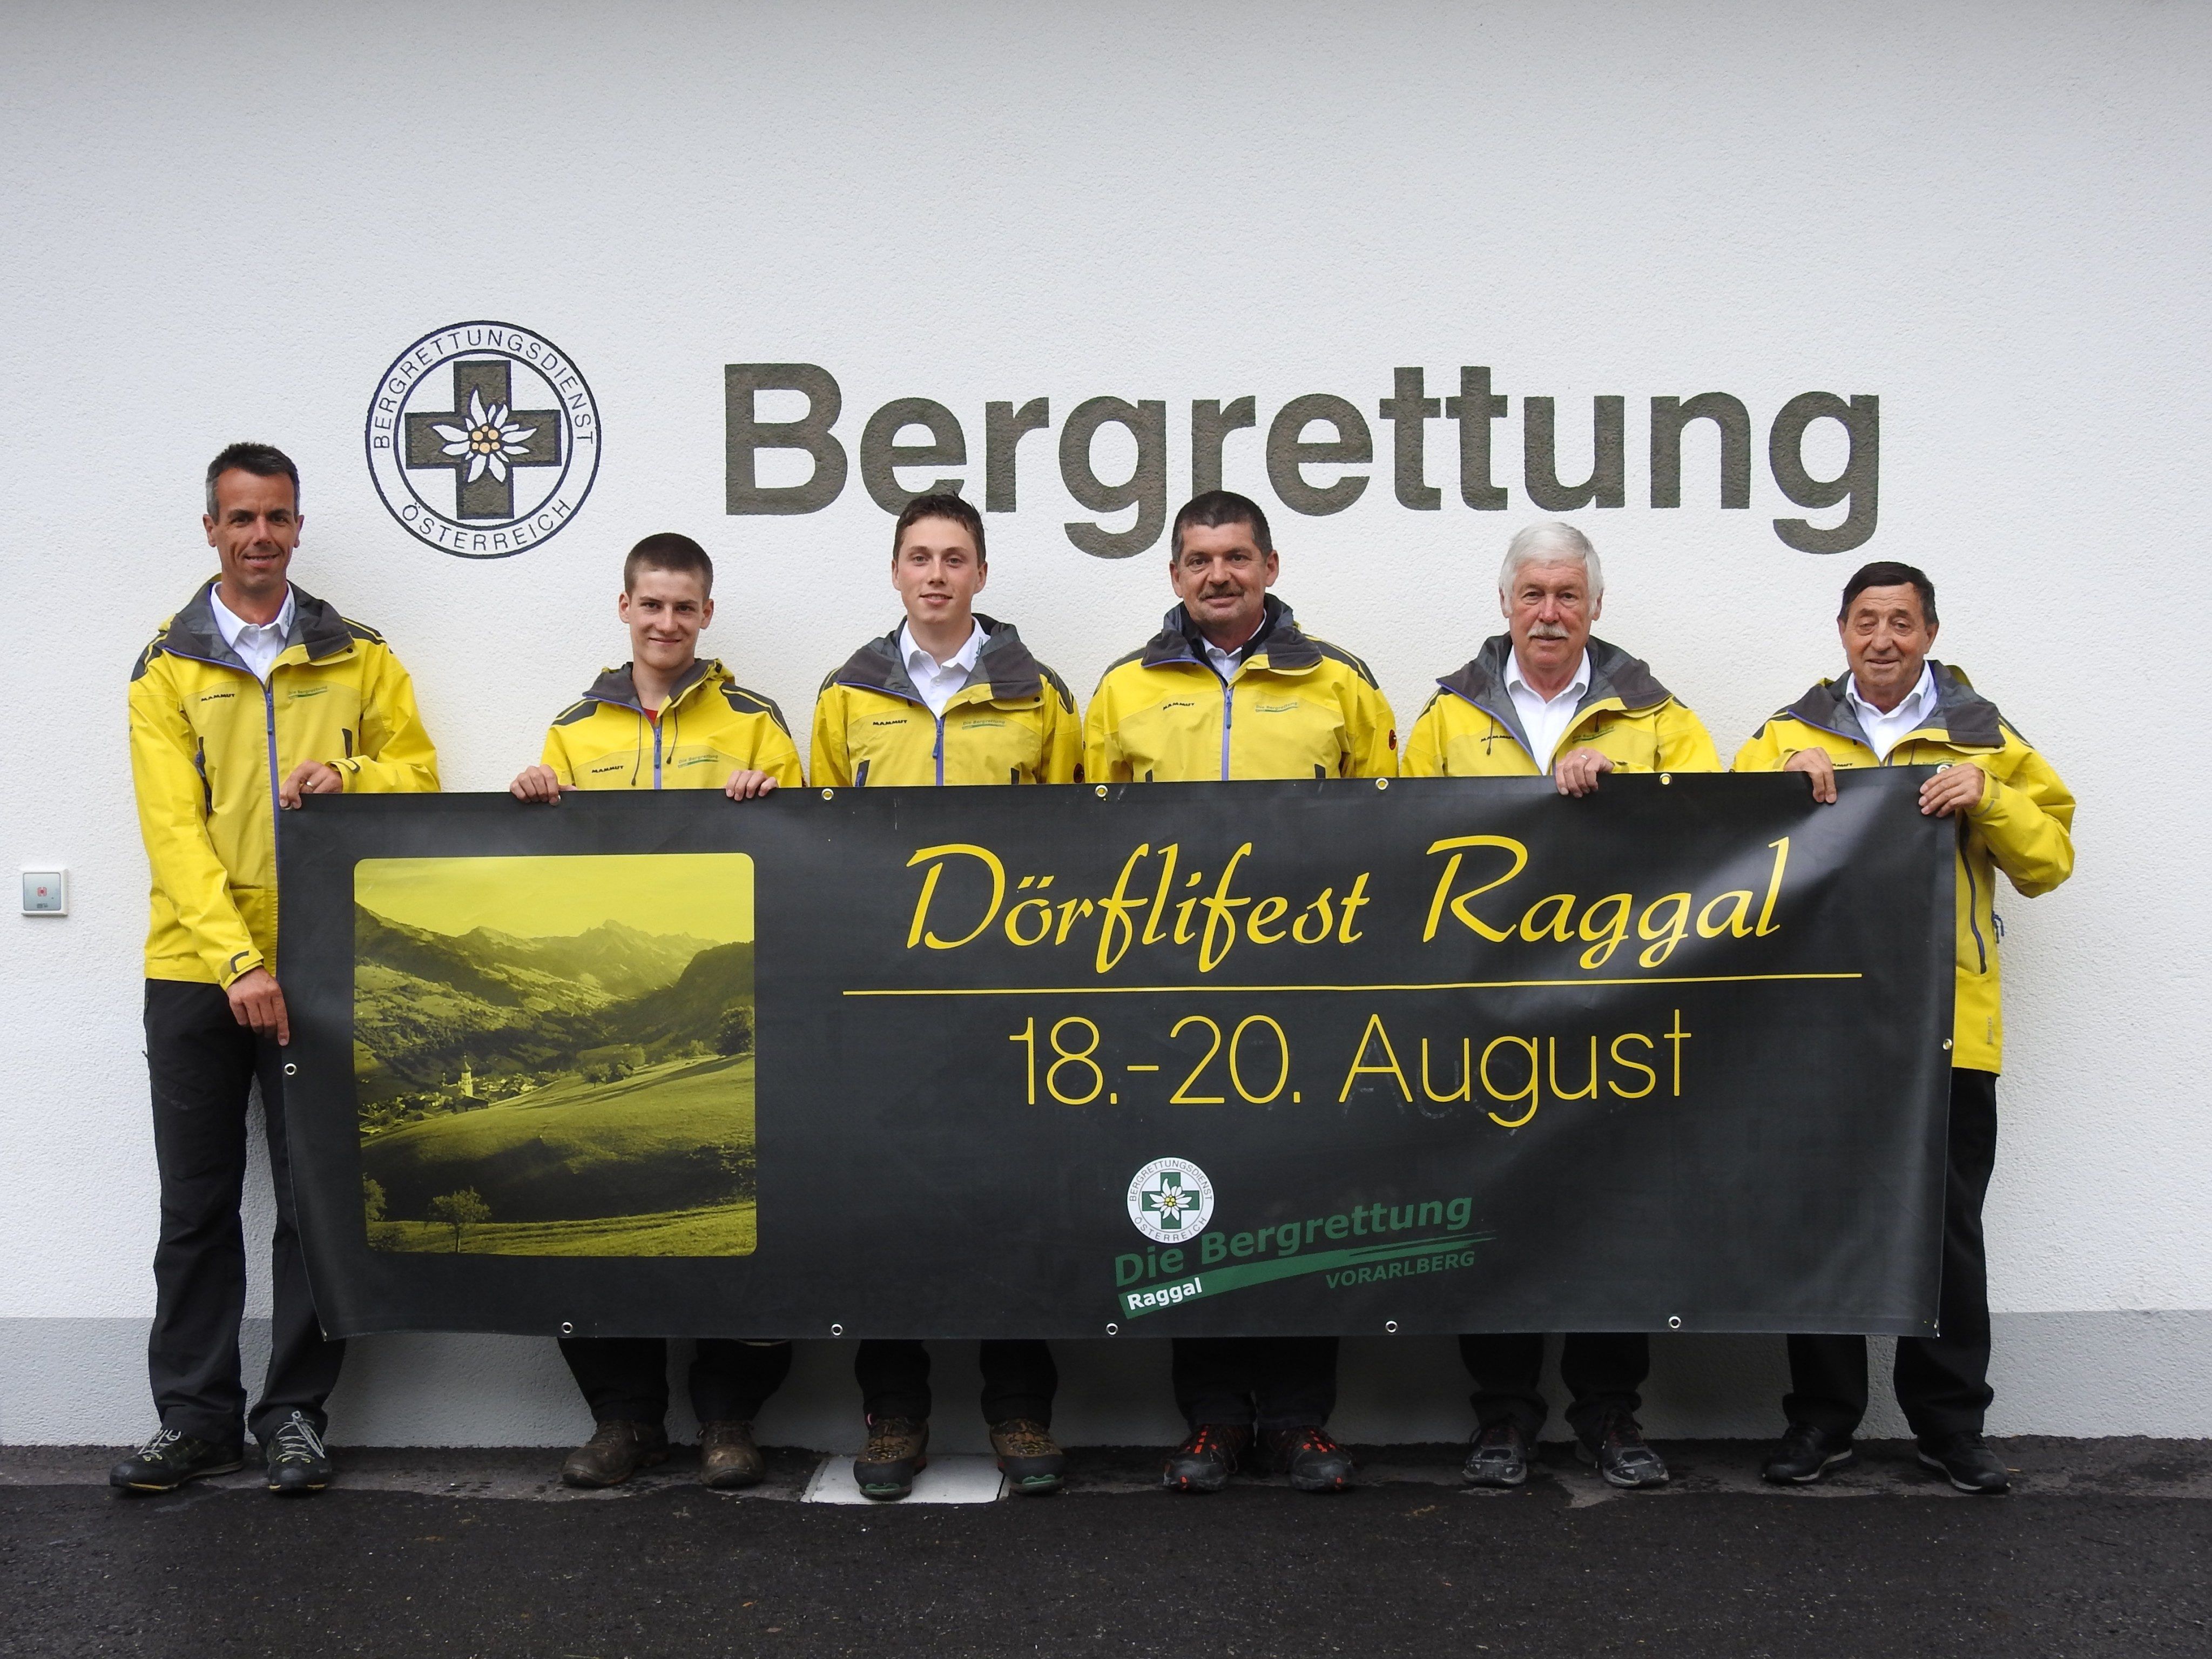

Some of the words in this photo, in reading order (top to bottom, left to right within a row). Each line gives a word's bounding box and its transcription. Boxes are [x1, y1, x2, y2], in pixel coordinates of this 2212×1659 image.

[374, 329, 593, 449] BERGRETTUNGSDIENST
[724, 363, 1880, 557] Bergrettung
[402, 499, 571, 551] ÖSTERREICH
[201, 693, 235, 702] MAMMUT
[1163, 702, 1195, 711] MAMMUT
[591, 765, 624, 773] MAMMUT
[907, 842, 1370, 974] Dörflifest
[1422, 835, 1786, 970] Raggal
[1009, 1015, 1301, 1105] 18.-20.
[1338, 1009, 1691, 1128] August
[1129, 1159, 1212, 1202] BERGRETTUNGSDIENST
[1115, 1245, 1184, 1287] Die
[1201, 1197, 1472, 1265] Bergrettung
[1134, 1216, 1207, 1242] ÖSTERREICH
[1325, 1251, 1475, 1289] VORARLBERG
[1127, 1277, 1203, 1310] Raggal
